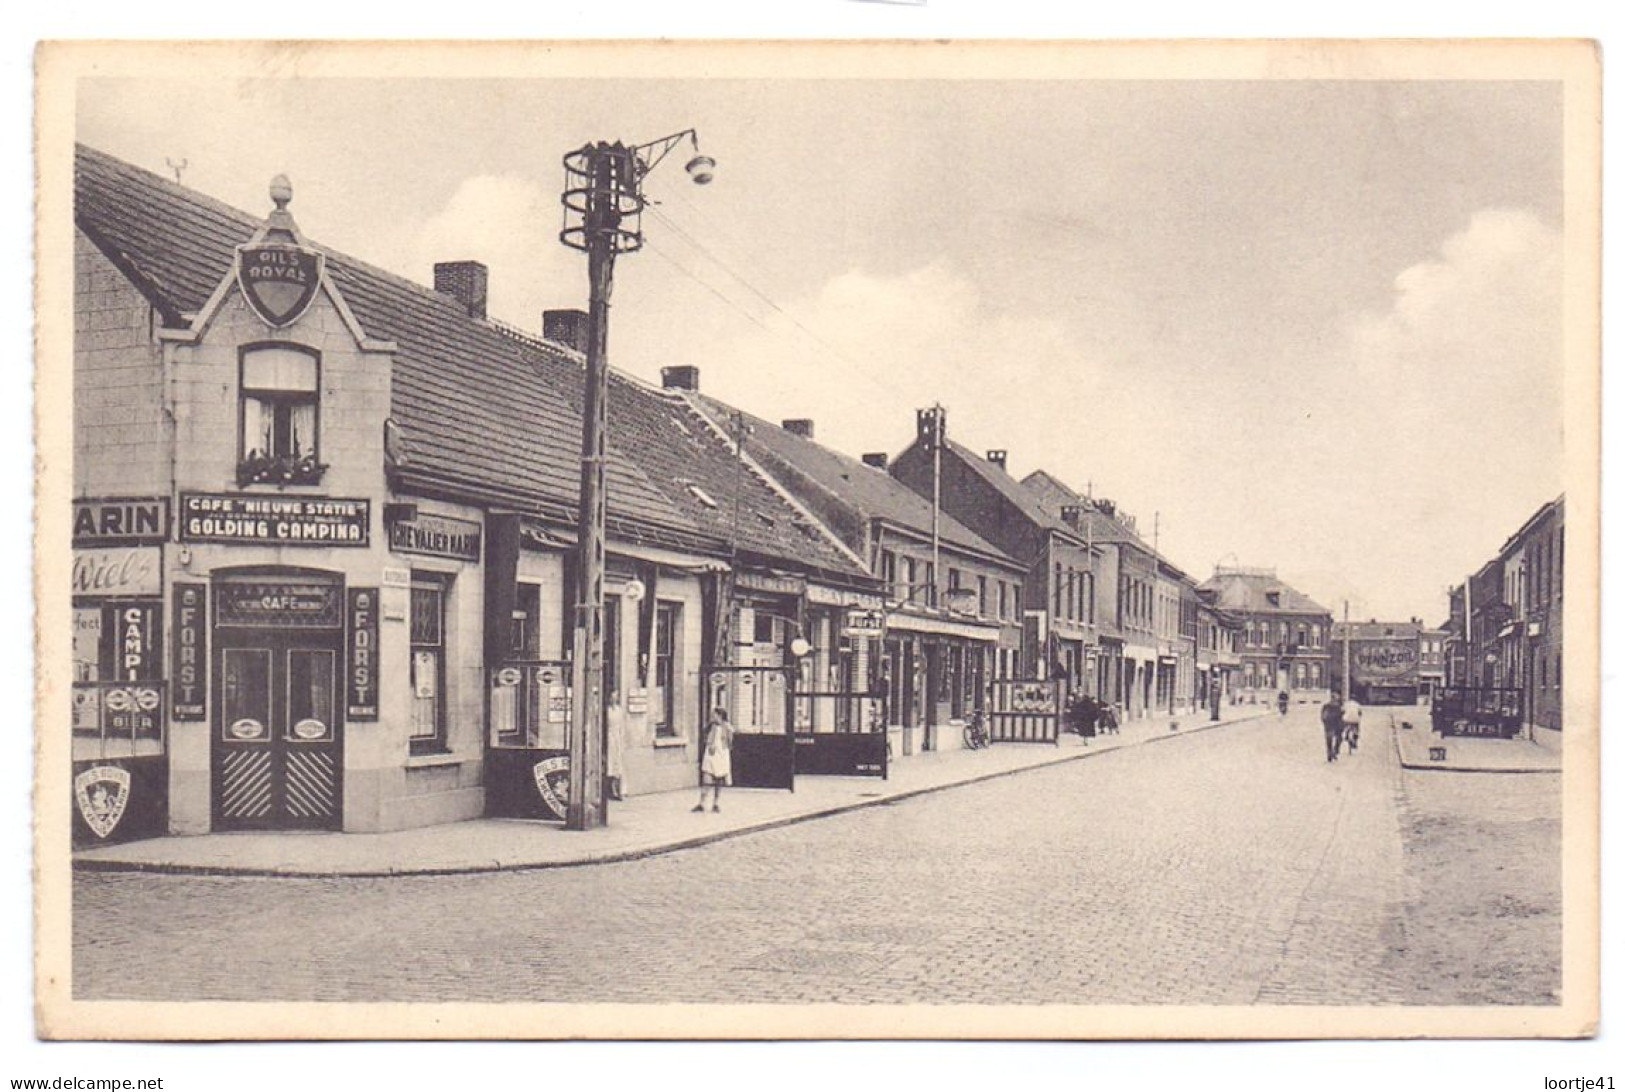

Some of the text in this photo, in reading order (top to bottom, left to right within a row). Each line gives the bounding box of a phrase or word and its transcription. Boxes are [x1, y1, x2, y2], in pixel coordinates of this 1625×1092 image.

[73, 505, 160, 535] ARIN
[188, 499, 233, 511] CAFE
[189, 518, 269, 537] GOLDING
[276, 522, 361, 540] CAMPINA
[181, 608, 196, 702] FORST
[355, 611, 369, 704] FORST
